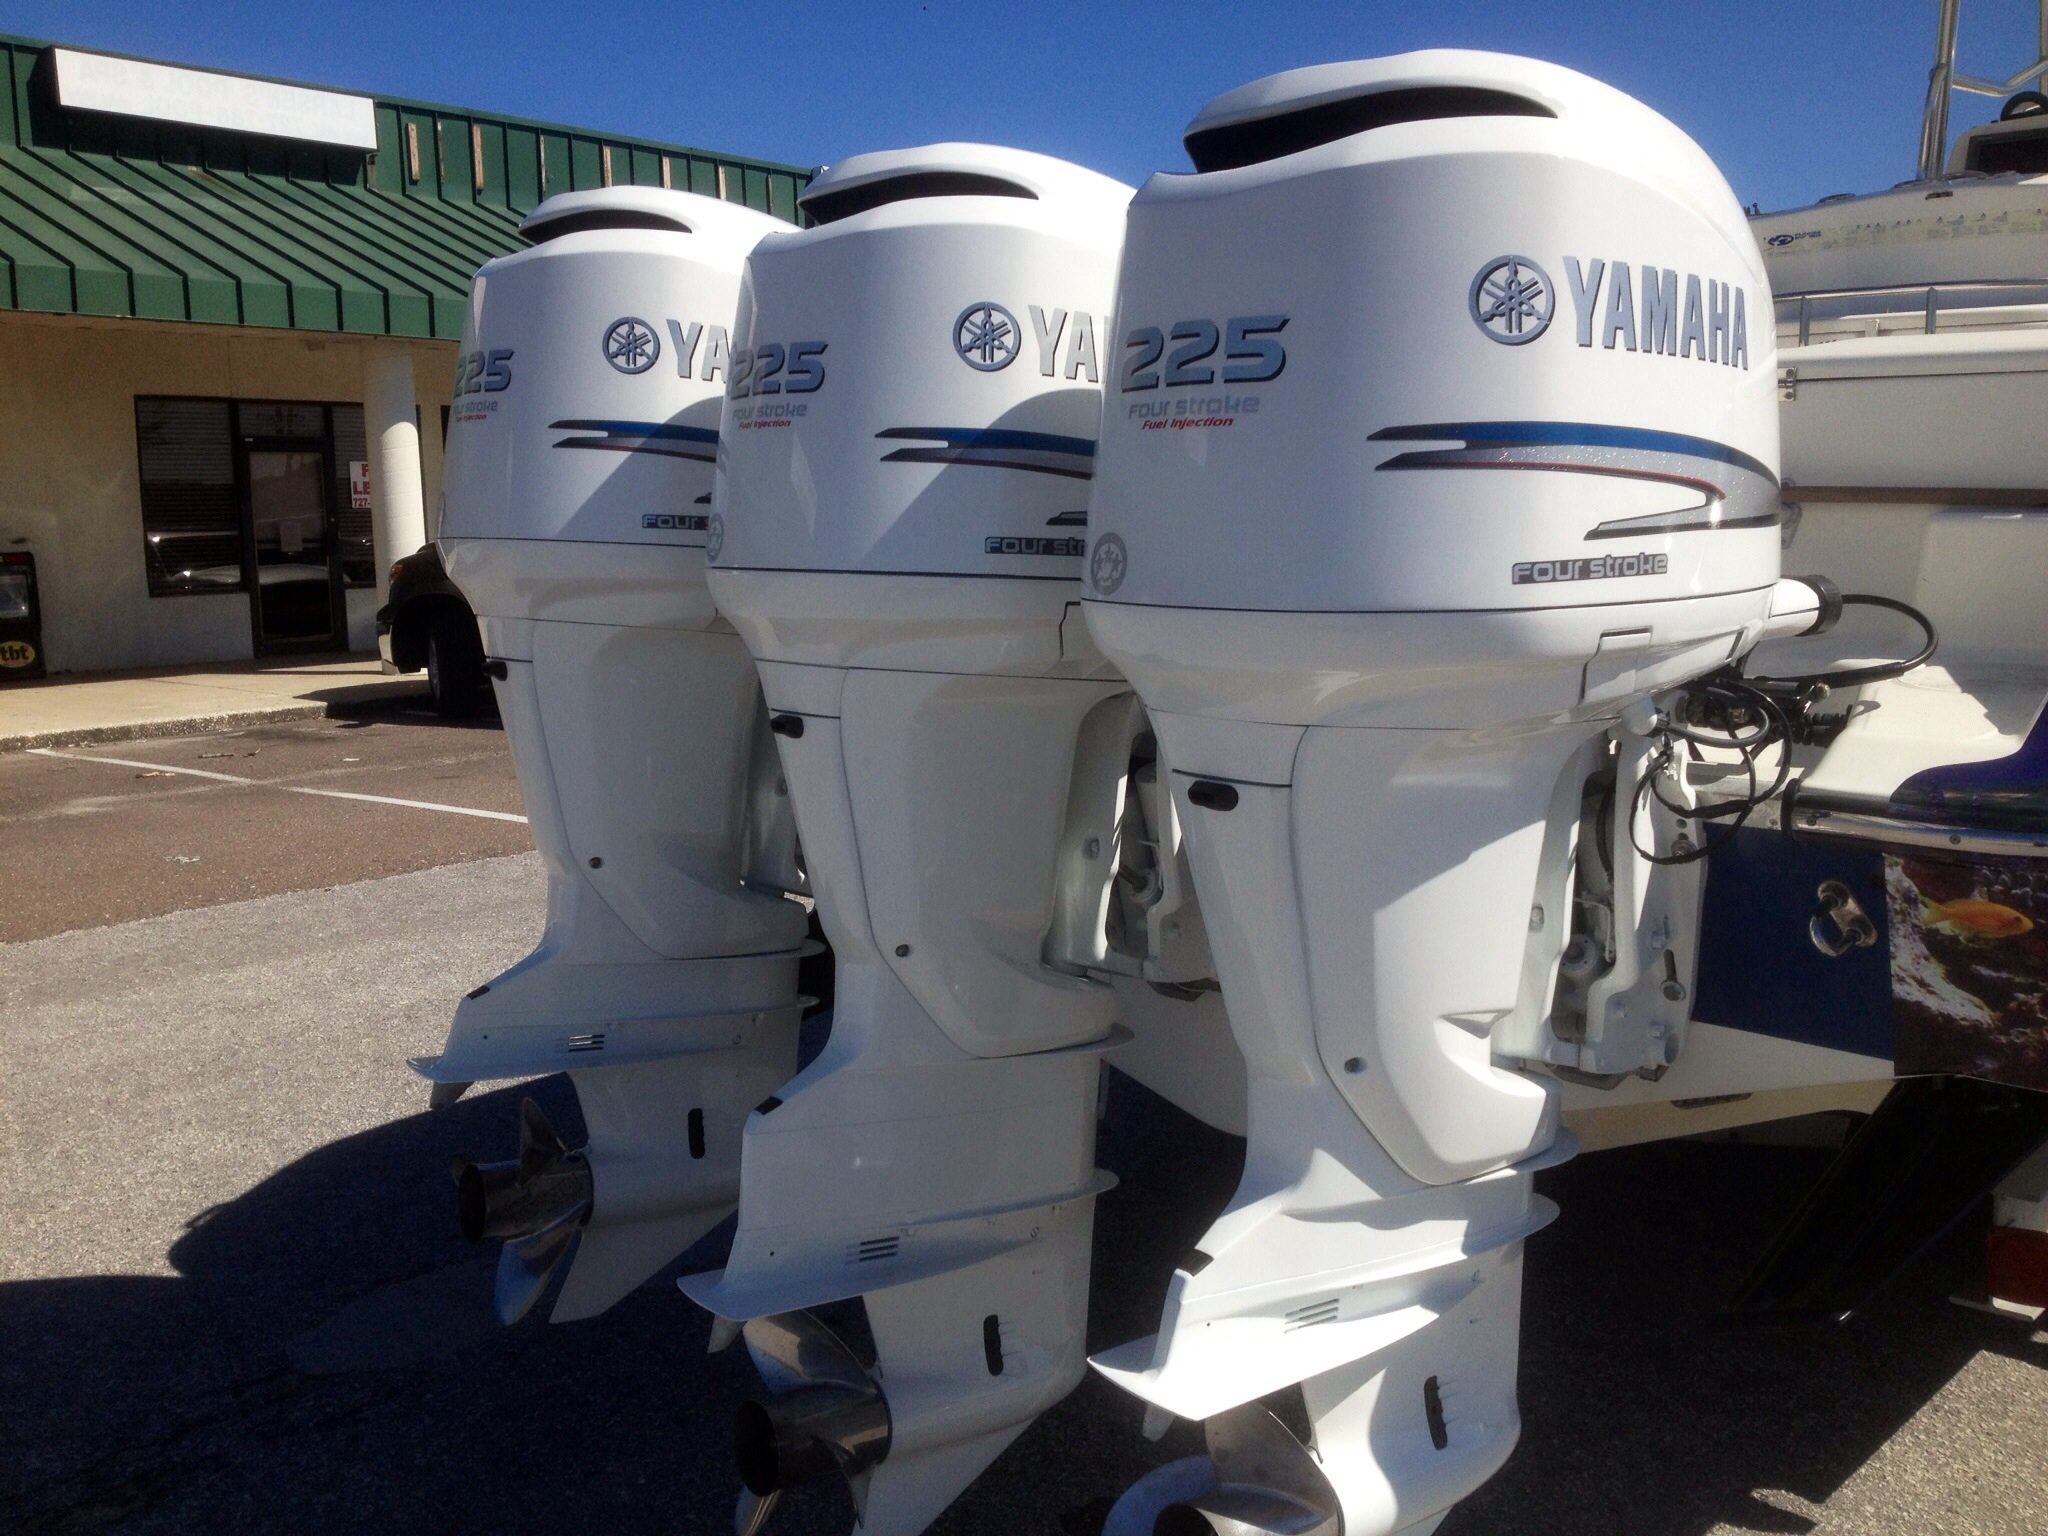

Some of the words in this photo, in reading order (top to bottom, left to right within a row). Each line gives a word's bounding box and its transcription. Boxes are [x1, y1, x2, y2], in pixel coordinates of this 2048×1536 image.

[1562, 256, 1748, 371] YAMAHA
[1121, 315, 1291, 393] 225
[731, 341, 829, 400] 225
[756, 402, 808, 418] stroke
[1174, 395, 1261, 416] stroke
[753, 420, 791, 430] Injection
[1142, 418, 1168, 431] Fuel
[1170, 416, 1234, 430] Injection
[1589, 552, 1668, 579] stroke
